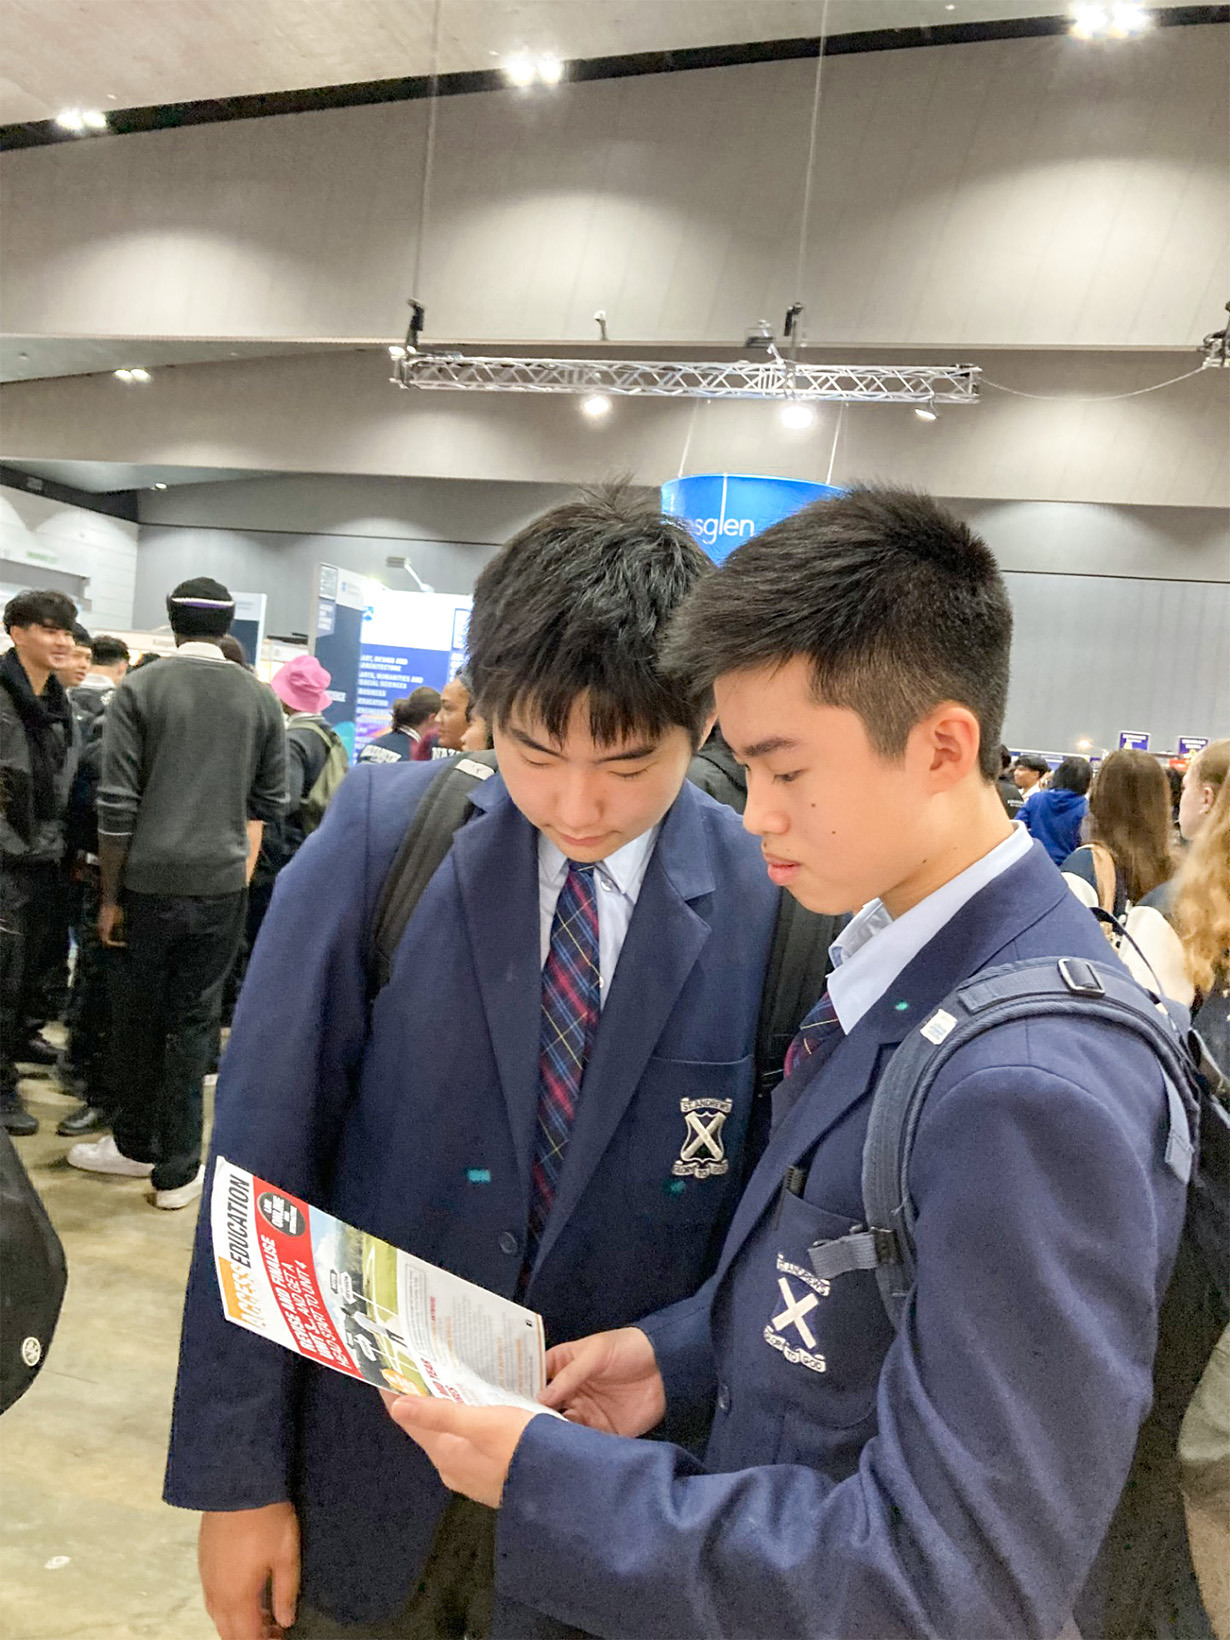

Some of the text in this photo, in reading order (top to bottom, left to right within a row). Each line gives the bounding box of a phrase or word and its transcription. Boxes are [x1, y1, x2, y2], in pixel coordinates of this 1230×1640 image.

[694, 516, 755, 545] sglen
[227, 1173, 252, 1269] EDUCATION
[271, 1195, 285, 1228] ONLINE
[281, 1262, 295, 1273] A
[283, 1269, 302, 1293] GET
[260, 1234, 317, 1353] REVISE AND FINALISE
[291, 1292, 311, 1318] AND
[294, 1259, 352, 1370] HEAD START TO UNIT 4
[308, 1331, 335, 1360] UNIT
